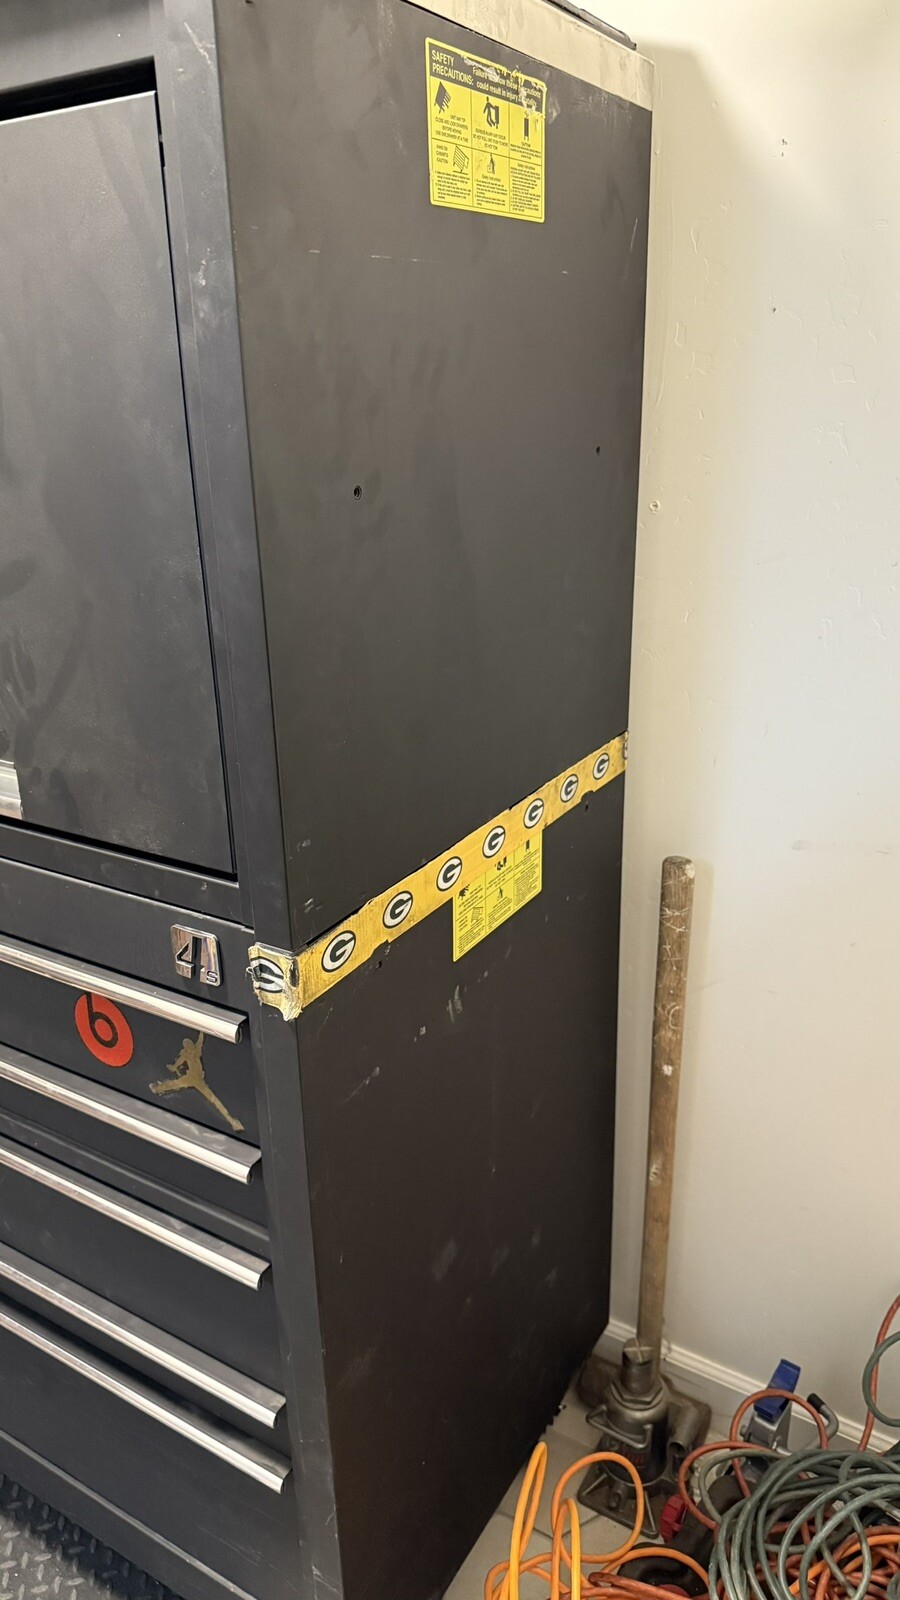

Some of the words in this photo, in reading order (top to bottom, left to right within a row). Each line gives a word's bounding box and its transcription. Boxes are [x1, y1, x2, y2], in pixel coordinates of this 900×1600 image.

[432, 50, 454, 66] SAFETY
[432, 63, 474, 86] PRECAUTIONS:
[476, 82, 489, 91] could
[490, 85, 501, 95] result
[502, 89, 506, 97] in
[507, 90, 518, 102] injury
[594, 753, 609, 779] G
[560, 774, 578, 802] G
[524, 798, 544, 828] G
[482, 826, 506, 858] G
[437, 856, 462, 891] G
[383, 891, 413, 928] G
[322, 930, 356, 972] G
